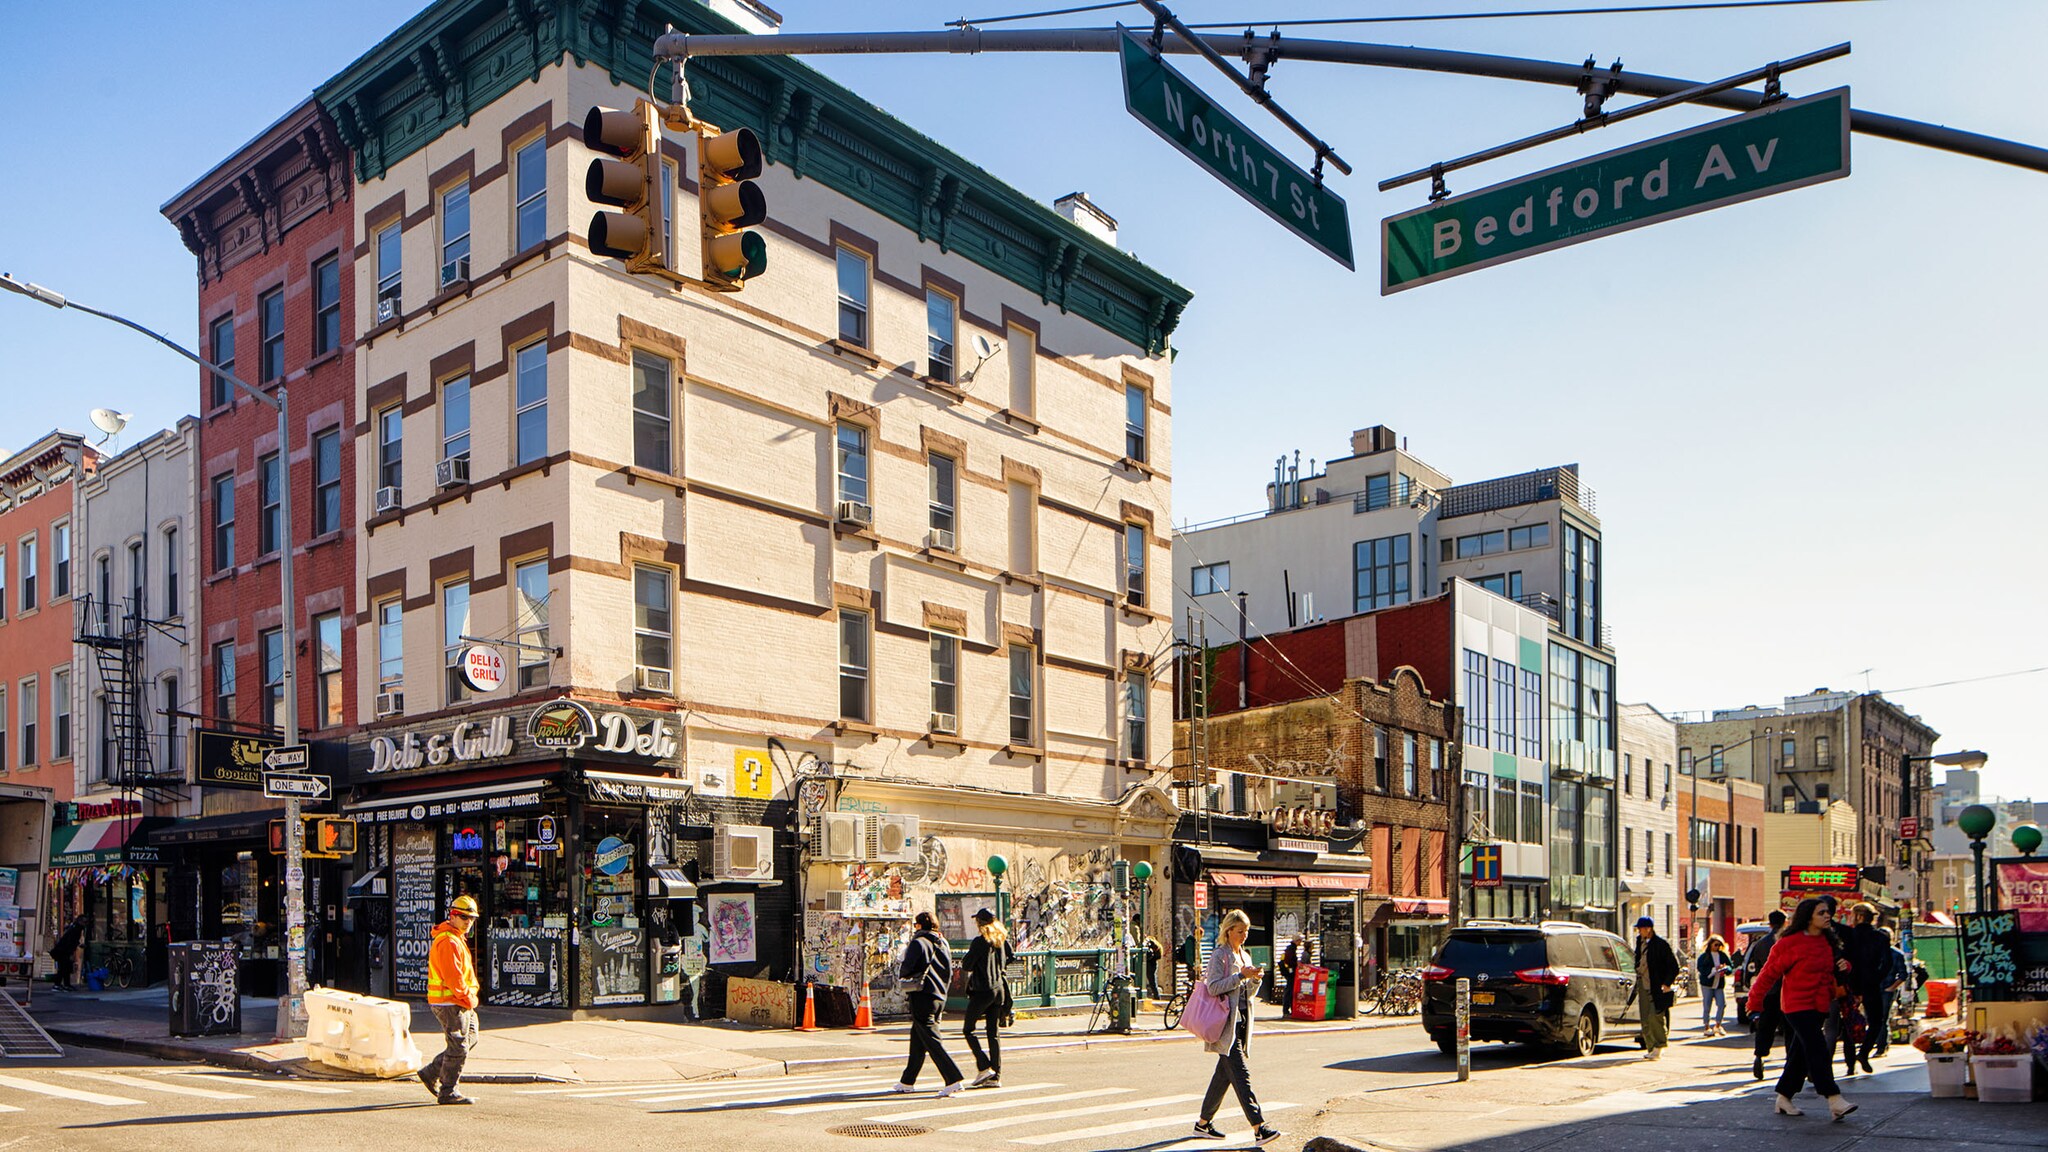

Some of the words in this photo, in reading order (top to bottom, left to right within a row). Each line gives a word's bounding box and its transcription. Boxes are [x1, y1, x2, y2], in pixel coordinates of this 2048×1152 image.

[1162, 80, 1258, 187] North
[1263, 160, 1279, 201] 7
[1290, 182, 1320, 231] St
[1433, 157, 1669, 259] Bedford
[1693, 138, 1780, 189] Av
[470, 653, 491, 667] DELI
[493, 656, 501, 668] &
[472, 667, 500, 682] GRILL
[545, 737, 571, 745] DELI
[594, 711, 678, 758] Deli
[366, 732, 424, 774] Deli
[427, 734, 449, 765] &
[452, 715, 513, 761] Grill
[268, 754, 282, 765] ONE
[287, 752, 302, 763] WAY
[274, 780, 294, 791] ONE
[302, 782, 321, 792] WAY
[645, 785, 660, 797] FREE
[660, 787, 686, 799] DELIVERY
[429, 804, 442, 816] BEER
[446, 802, 457, 814] DELI
[461, 800, 484, 813] GROCERY
[488, 796, 511, 809] ORGANIC
[511, 793, 540, 807] PRODUCTS
[376, 811, 387, 821] FREE
[388, 808, 408, 820] DELIVERY
[1271, 806, 1335, 837] OASIS
[129, 852, 159, 860] PIZZA
[397, 888, 423, 900] Coffee
[1054, 957, 1081, 969] Subway
